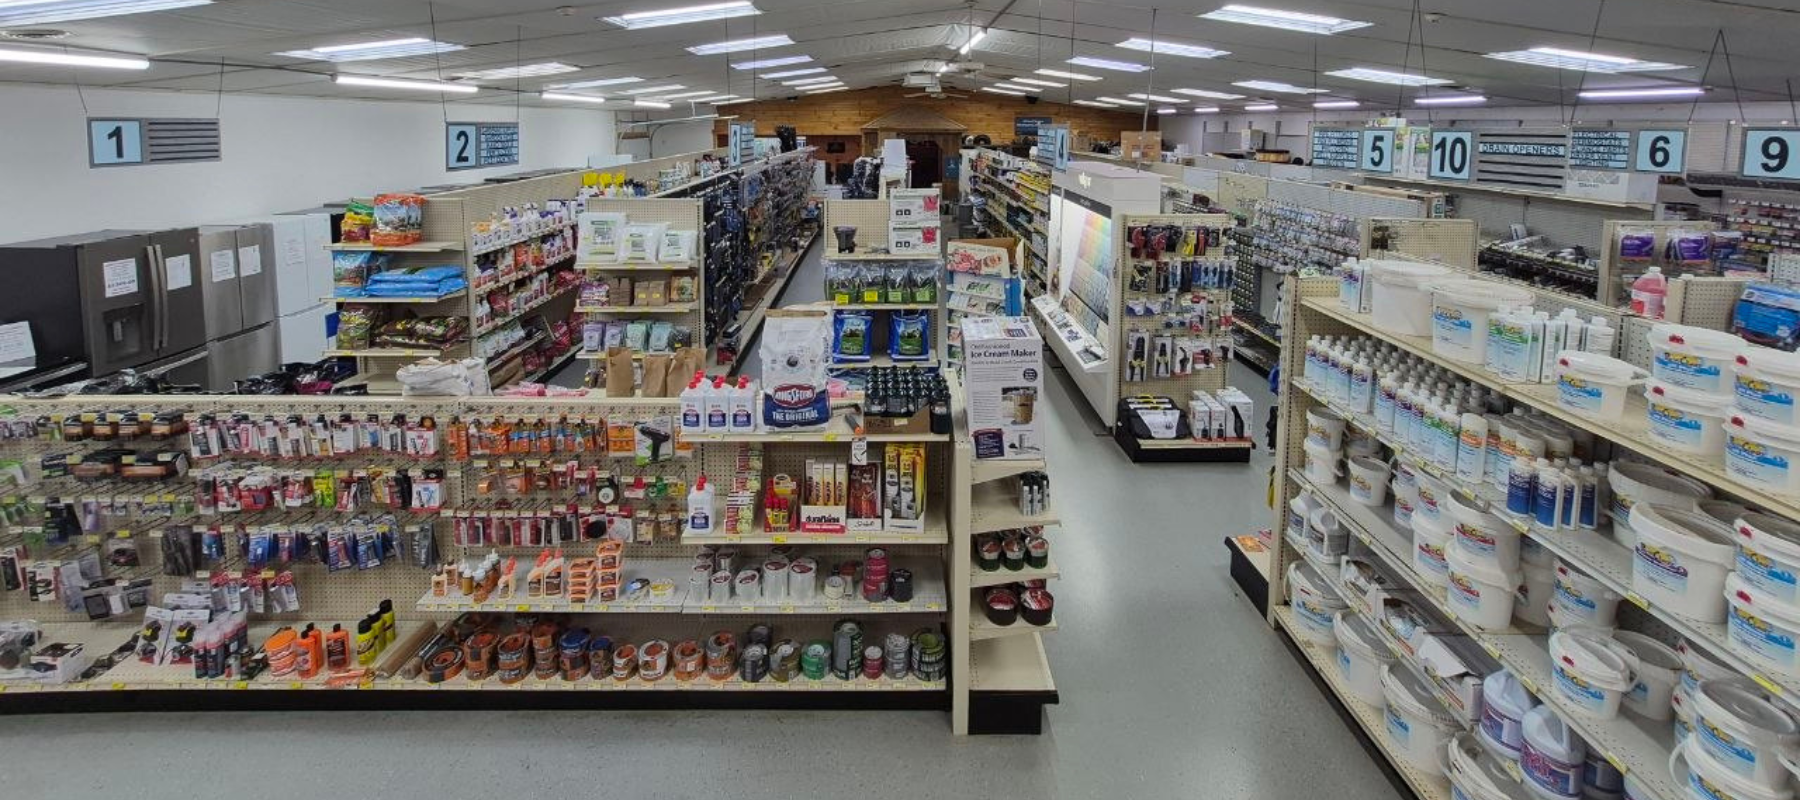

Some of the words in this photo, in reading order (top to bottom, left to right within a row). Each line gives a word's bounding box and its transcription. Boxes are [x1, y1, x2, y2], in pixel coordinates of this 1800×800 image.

[107, 125, 123, 159] 1
[456, 130, 469, 163] 2
[732, 129, 738, 163] 3
[1058, 134, 1064, 160] 4
[1370, 135, 1385, 167] 5
[1434, 137, 1467, 174] 10
[1481, 143, 1510, 154] DRAIN
[1513, 144, 1560, 155] OPENERS
[1650, 135, 1670, 167] 6
[1761, 136, 1789, 173] 9
[984, 350, 1009, 358] Cream
[1011, 349, 1036, 357] Maker
[772, 411, 784, 421] THE
